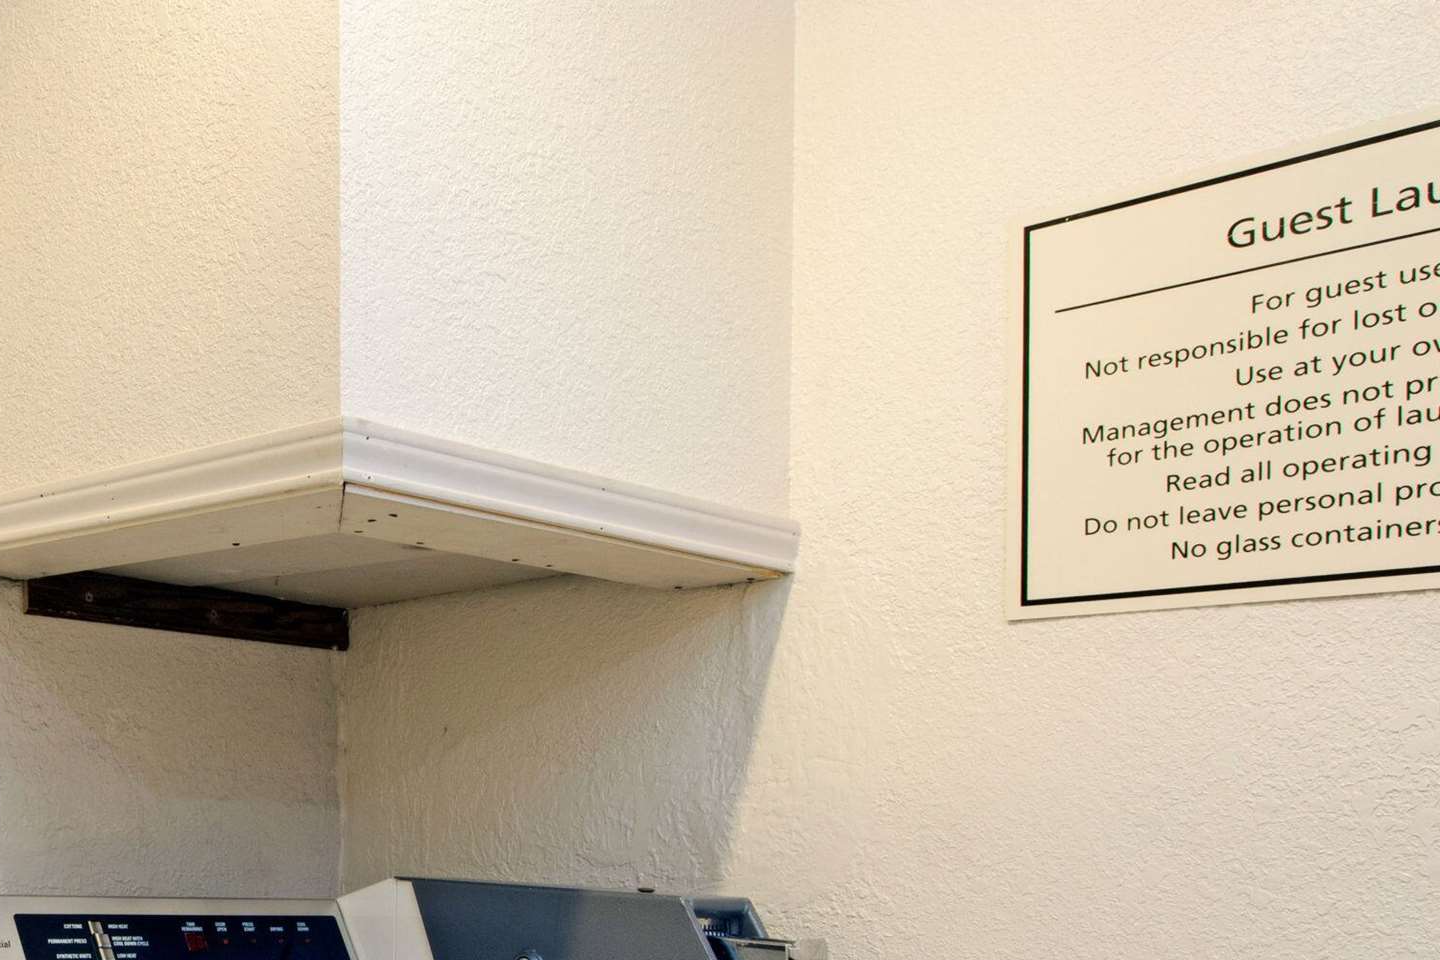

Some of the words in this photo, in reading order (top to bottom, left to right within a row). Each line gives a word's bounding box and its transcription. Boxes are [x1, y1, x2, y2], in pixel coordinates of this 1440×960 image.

[1227, 196, 1352, 248] Guest
[1252, 291, 1295, 314] For
[1305, 271, 1387, 308] guest
[1085, 356, 1129, 379] Not
[1138, 326, 1288, 370] responsible
[1299, 318, 1342, 339] for
[1354, 304, 1407, 330] lost
[1236, 365, 1283, 386] Use
[1294, 356, 1322, 376] at
[1332, 344, 1401, 376] your
[1082, 402, 1255, 444] Management
[1265, 393, 1332, 416] does
[1343, 380, 1394, 405] not
[1406, 376, 1438, 401] pr
[1107, 448, 1143, 467] for
[1152, 440, 1194, 461] the
[1204, 421, 1341, 456] operation
[1354, 408, 1386, 432] of
[1398, 405, 1440, 426] lau
[1166, 466, 1230, 492] Read
[1241, 460, 1271, 483] all
[1283, 445, 1431, 480] operating
[1085, 518, 1117, 535] Do
[1127, 511, 1169, 531] not
[1180, 504, 1247, 525] leave
[1259, 482, 1382, 521] personal
[1171, 541, 1207, 560] No
[1216, 534, 1281, 560] glass
[1292, 519, 1440, 548] container
